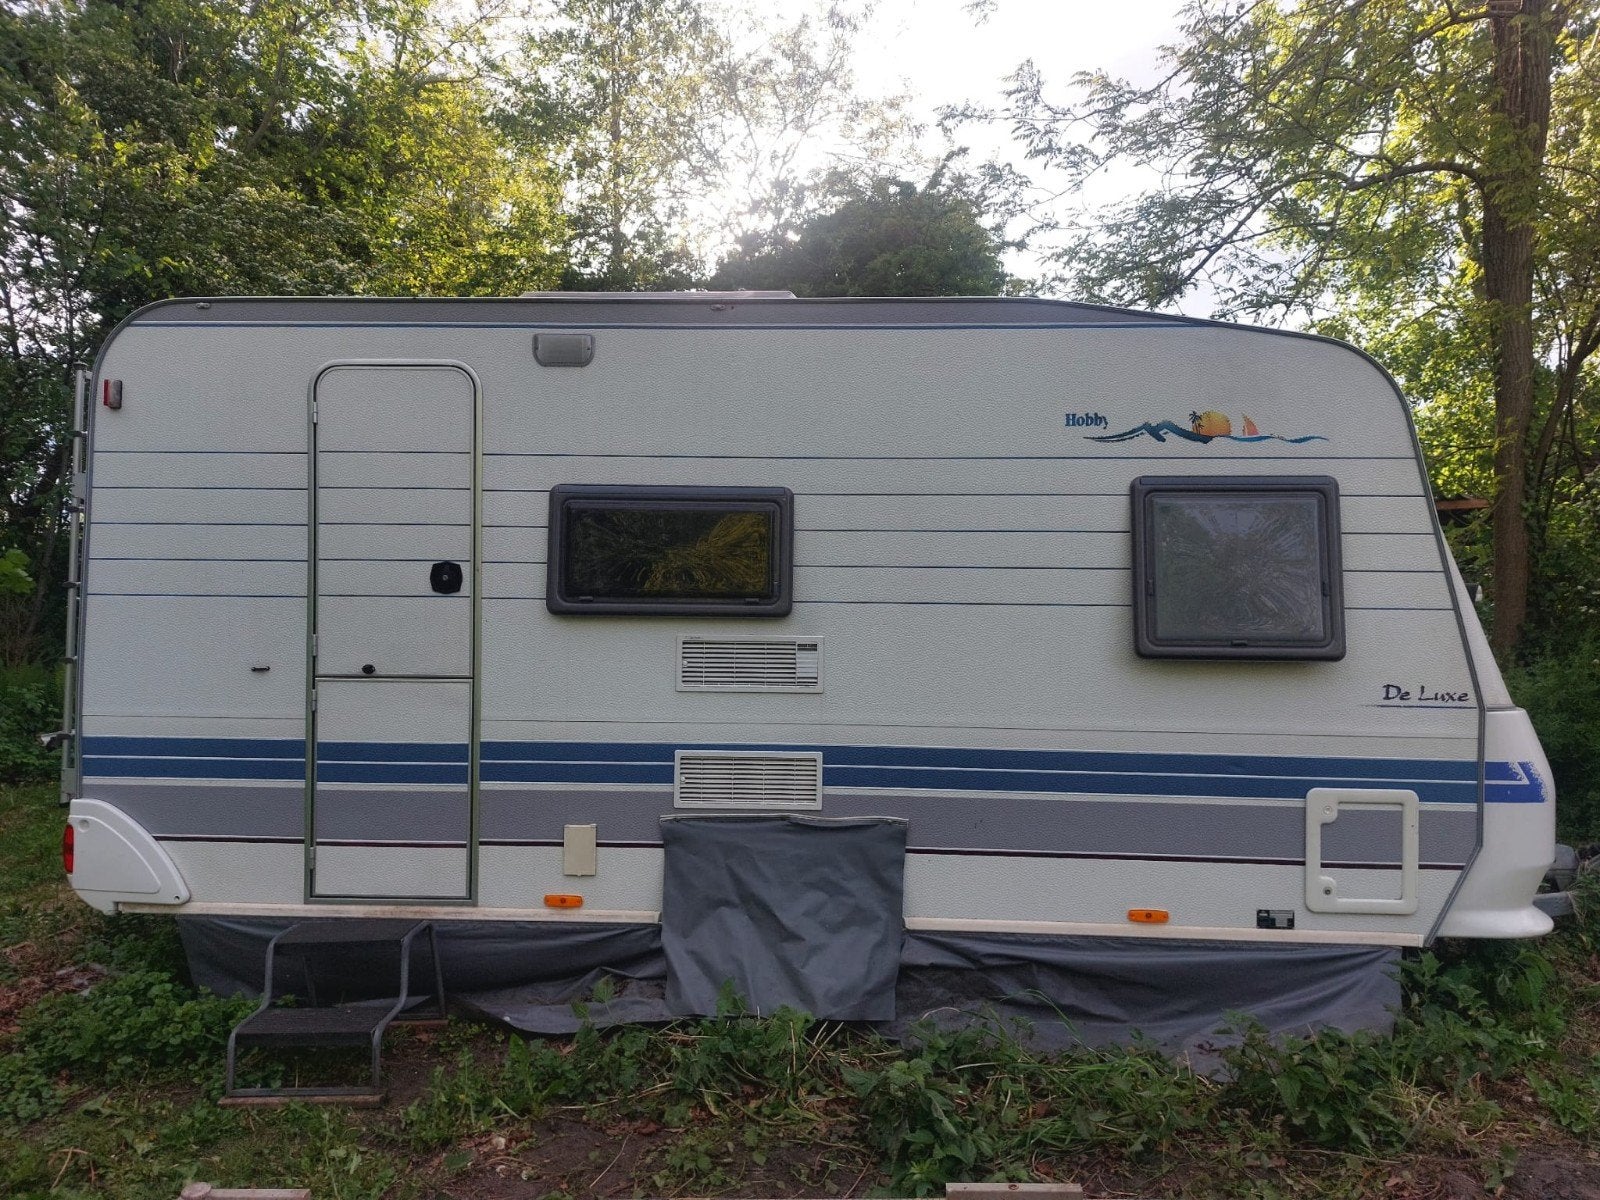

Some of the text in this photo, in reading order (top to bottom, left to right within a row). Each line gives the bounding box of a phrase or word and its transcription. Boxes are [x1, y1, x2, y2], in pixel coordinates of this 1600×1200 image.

[1065, 412, 1108, 429] Hobby
[1382, 684, 1469, 702] De Luxe
